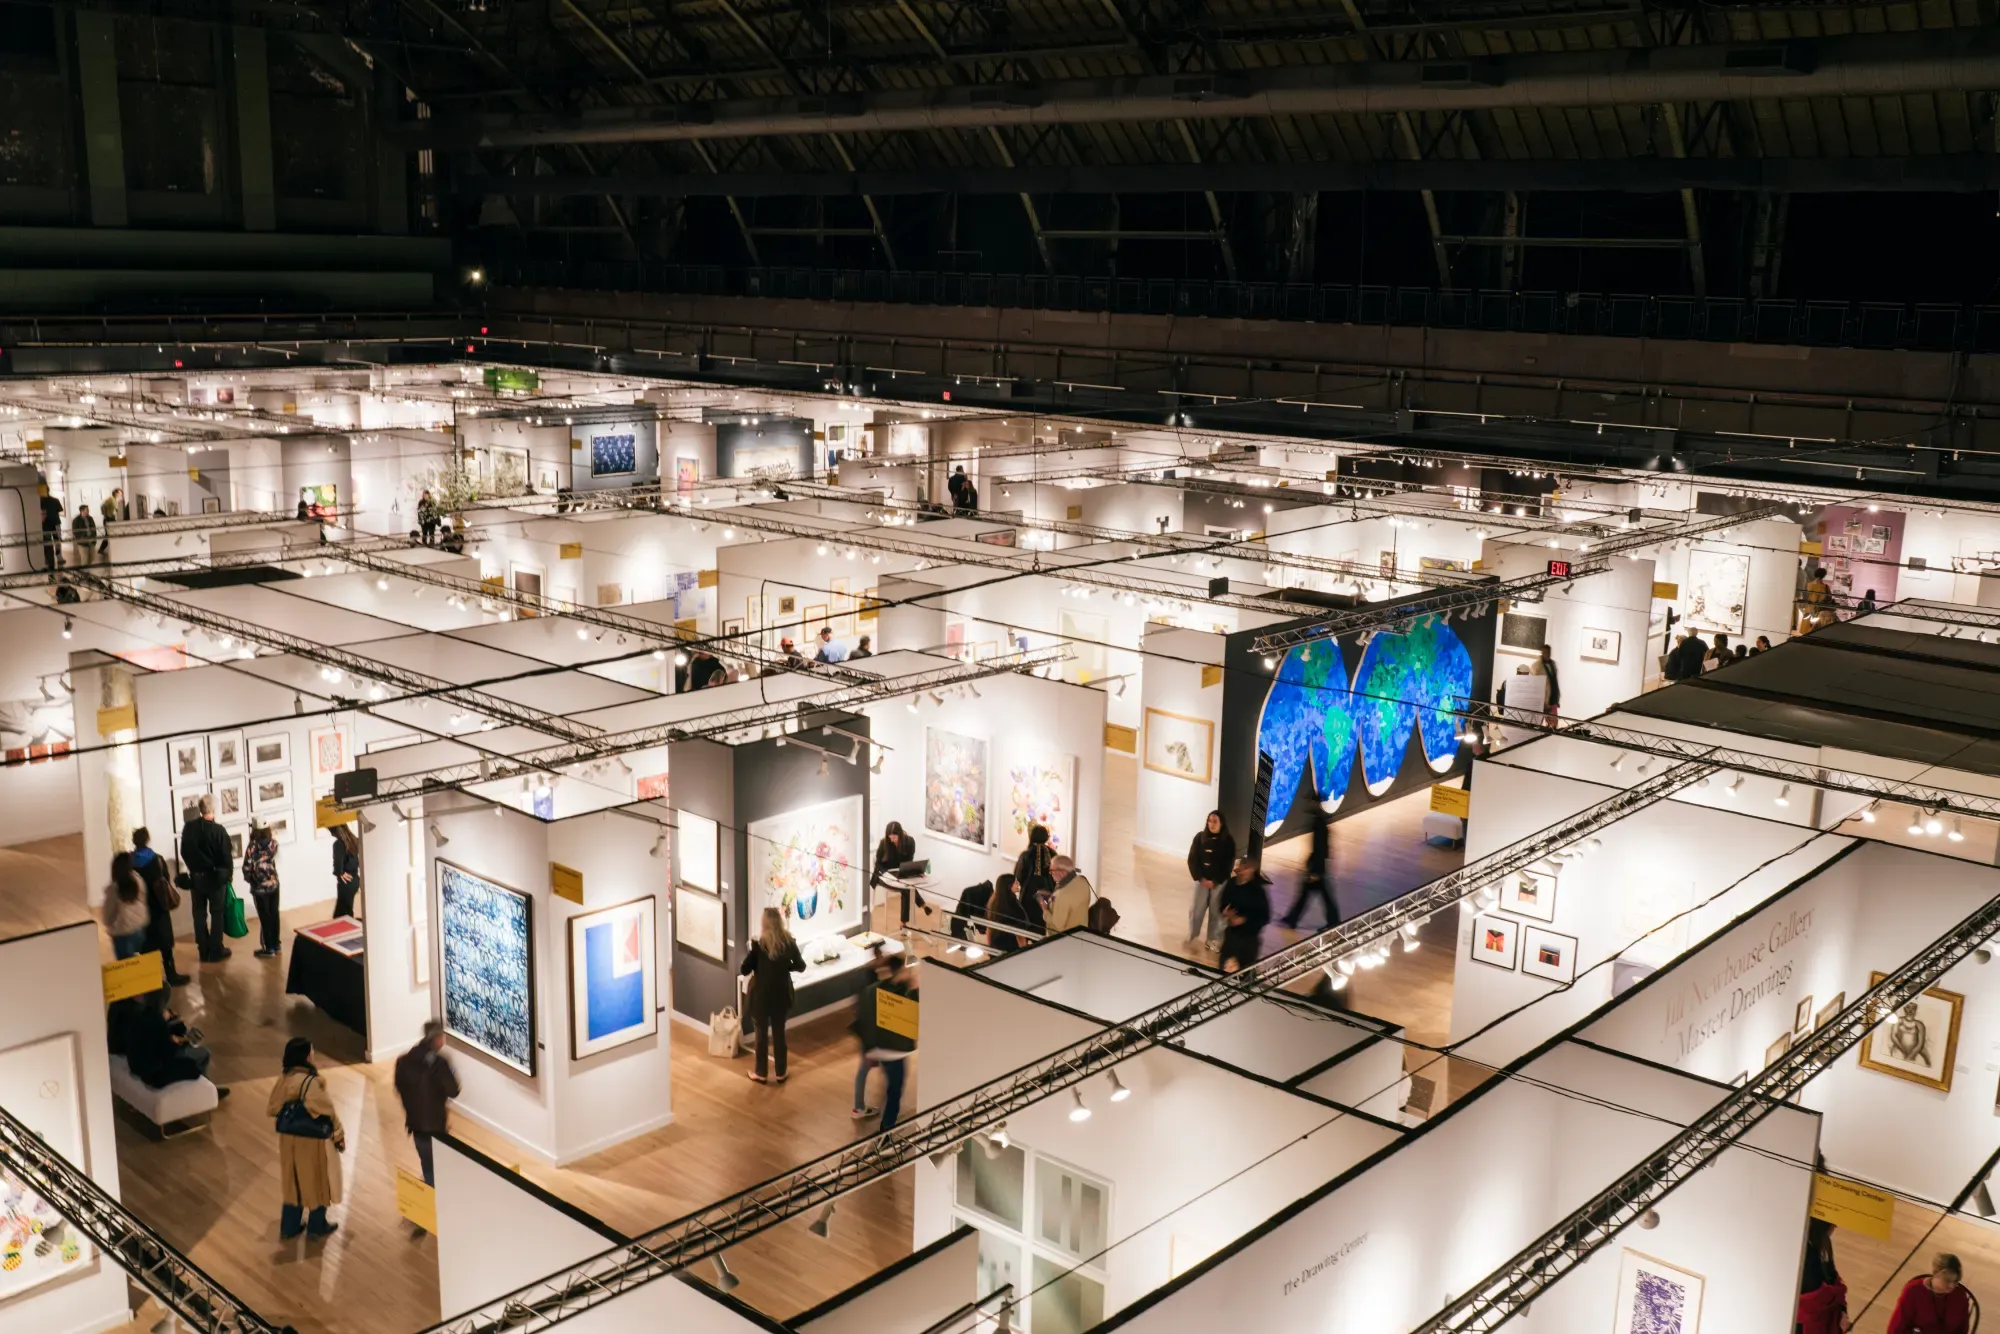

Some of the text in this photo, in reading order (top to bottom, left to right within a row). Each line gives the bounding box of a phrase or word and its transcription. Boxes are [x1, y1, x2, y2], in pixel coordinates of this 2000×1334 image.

[1551, 561, 1568, 576] EXIT
[1769, 908, 1815, 953] Gallery
[1729, 960, 1793, 1021] Drawings
[1818, 1176, 1885, 1203] The Drawing Center
[1284, 1278, 1300, 1296] The
[1301, 1250, 1340, 1283] Drawing
